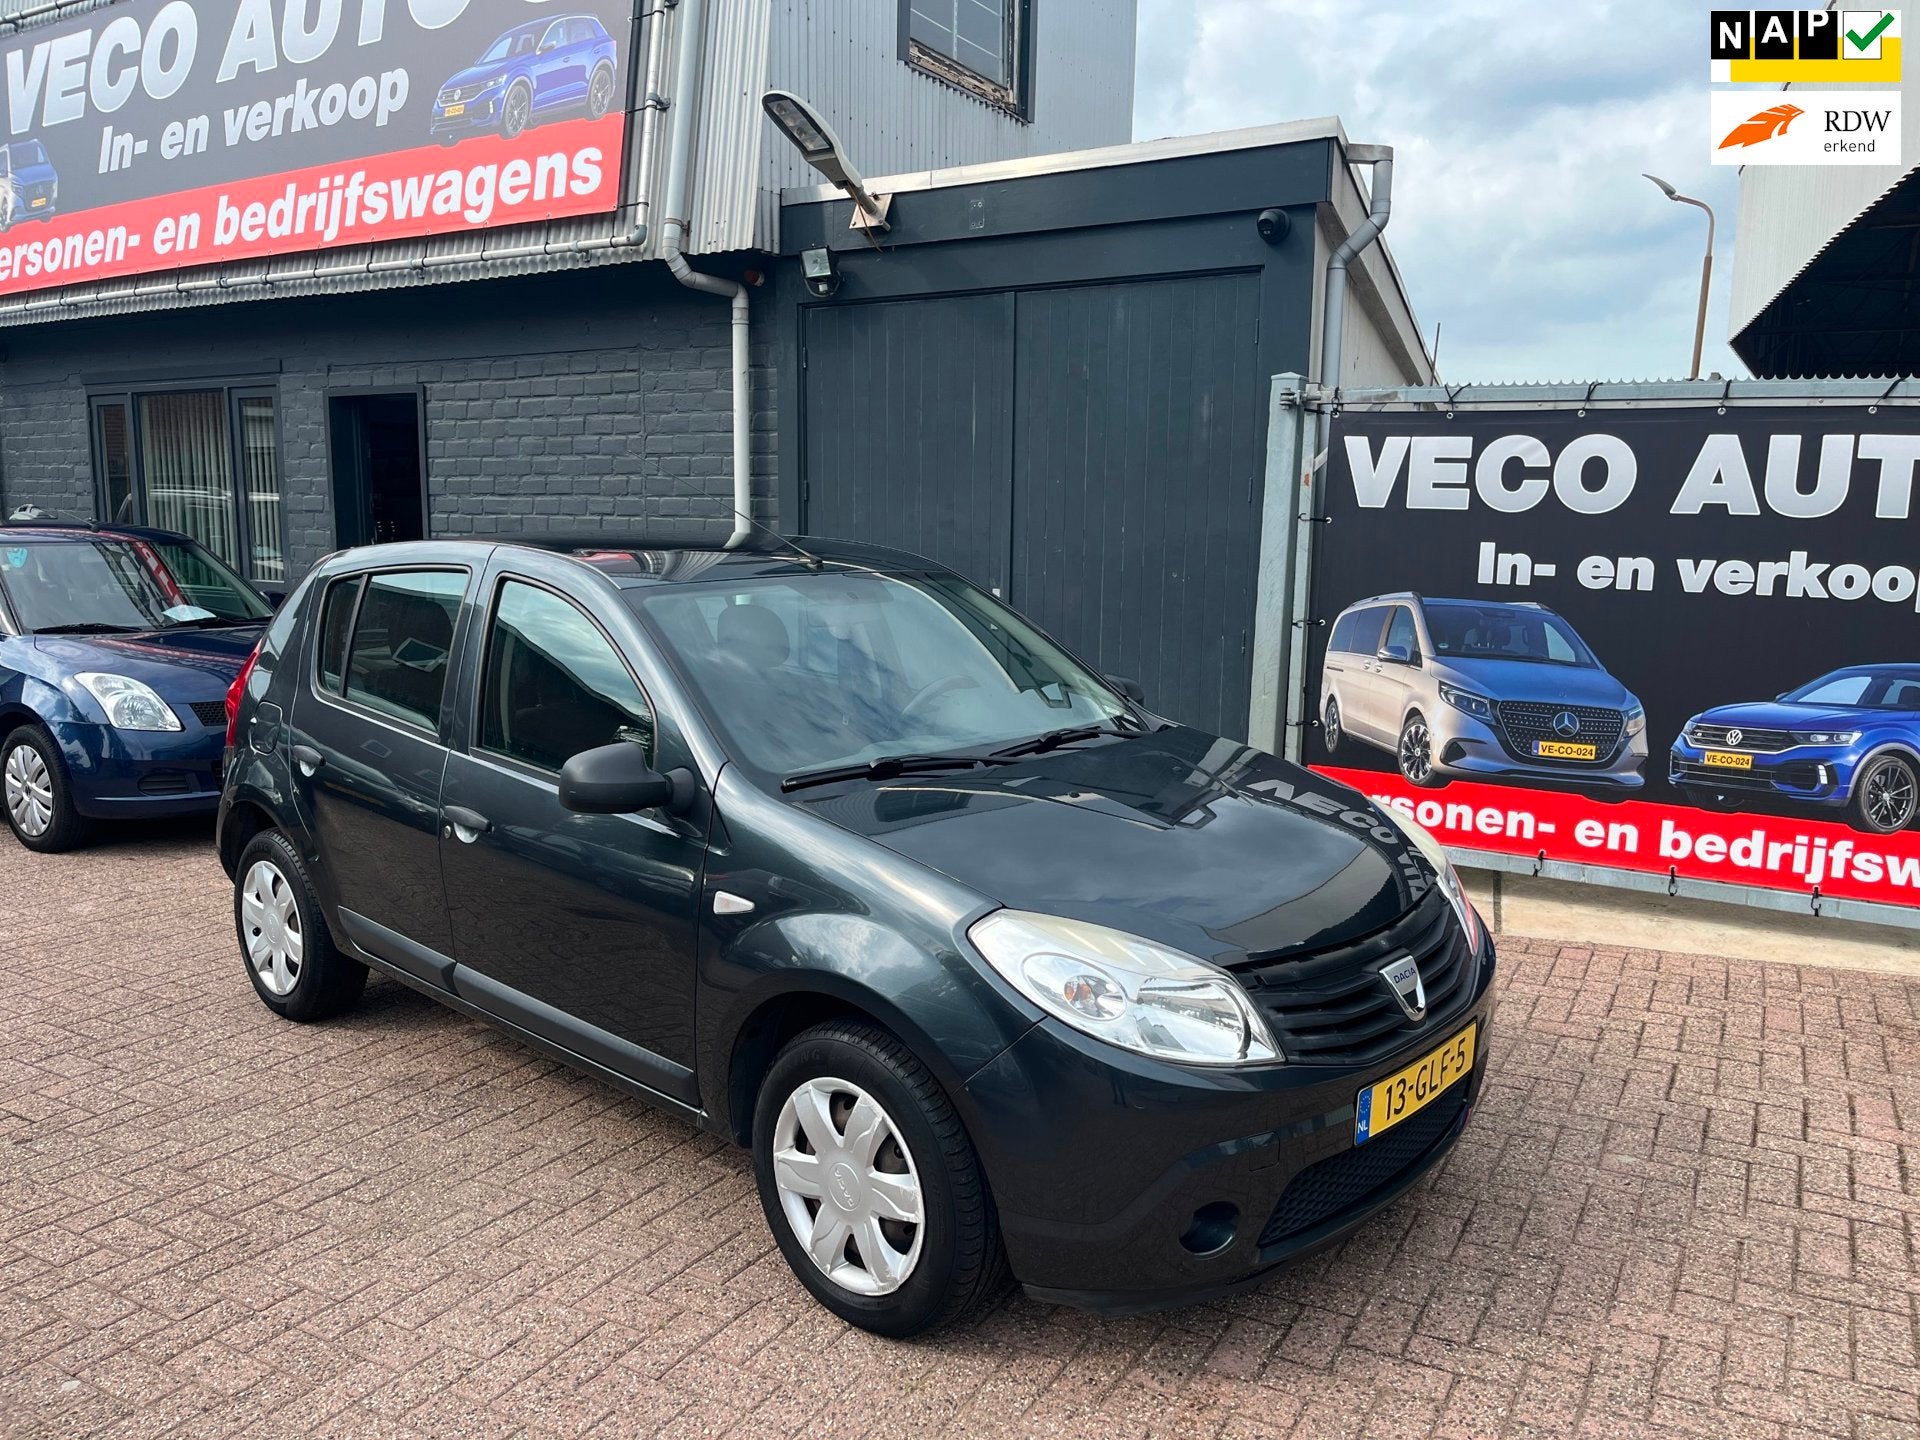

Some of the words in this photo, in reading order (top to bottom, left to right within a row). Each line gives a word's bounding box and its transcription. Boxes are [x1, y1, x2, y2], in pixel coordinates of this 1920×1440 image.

[6, 0, 199, 135] VECO
[215, 0, 471, 83] AU
[98, 125, 149, 175] In-
[160, 114, 209, 160] en
[224, 67, 410, 147] verkoop
[153, 211, 201, 255] en
[213, 145, 604, 247] bedrijfswagens
[1344, 433, 1638, 514] VECO
[1477, 541, 1556, 585] In-
[1577, 555, 1655, 592] en
[1676, 551, 1920, 613] verkoo
[1541, 745, 1594, 757] VE-CO-024
[1706, 753, 1751, 767] VE-CO-024
[1574, 818, 1639, 851] en
[1393, 967, 1416, 984] DACIA
[1386, 1037, 1466, 1121] 13-GLF-5
[1357, 1119, 1368, 1134] NL
